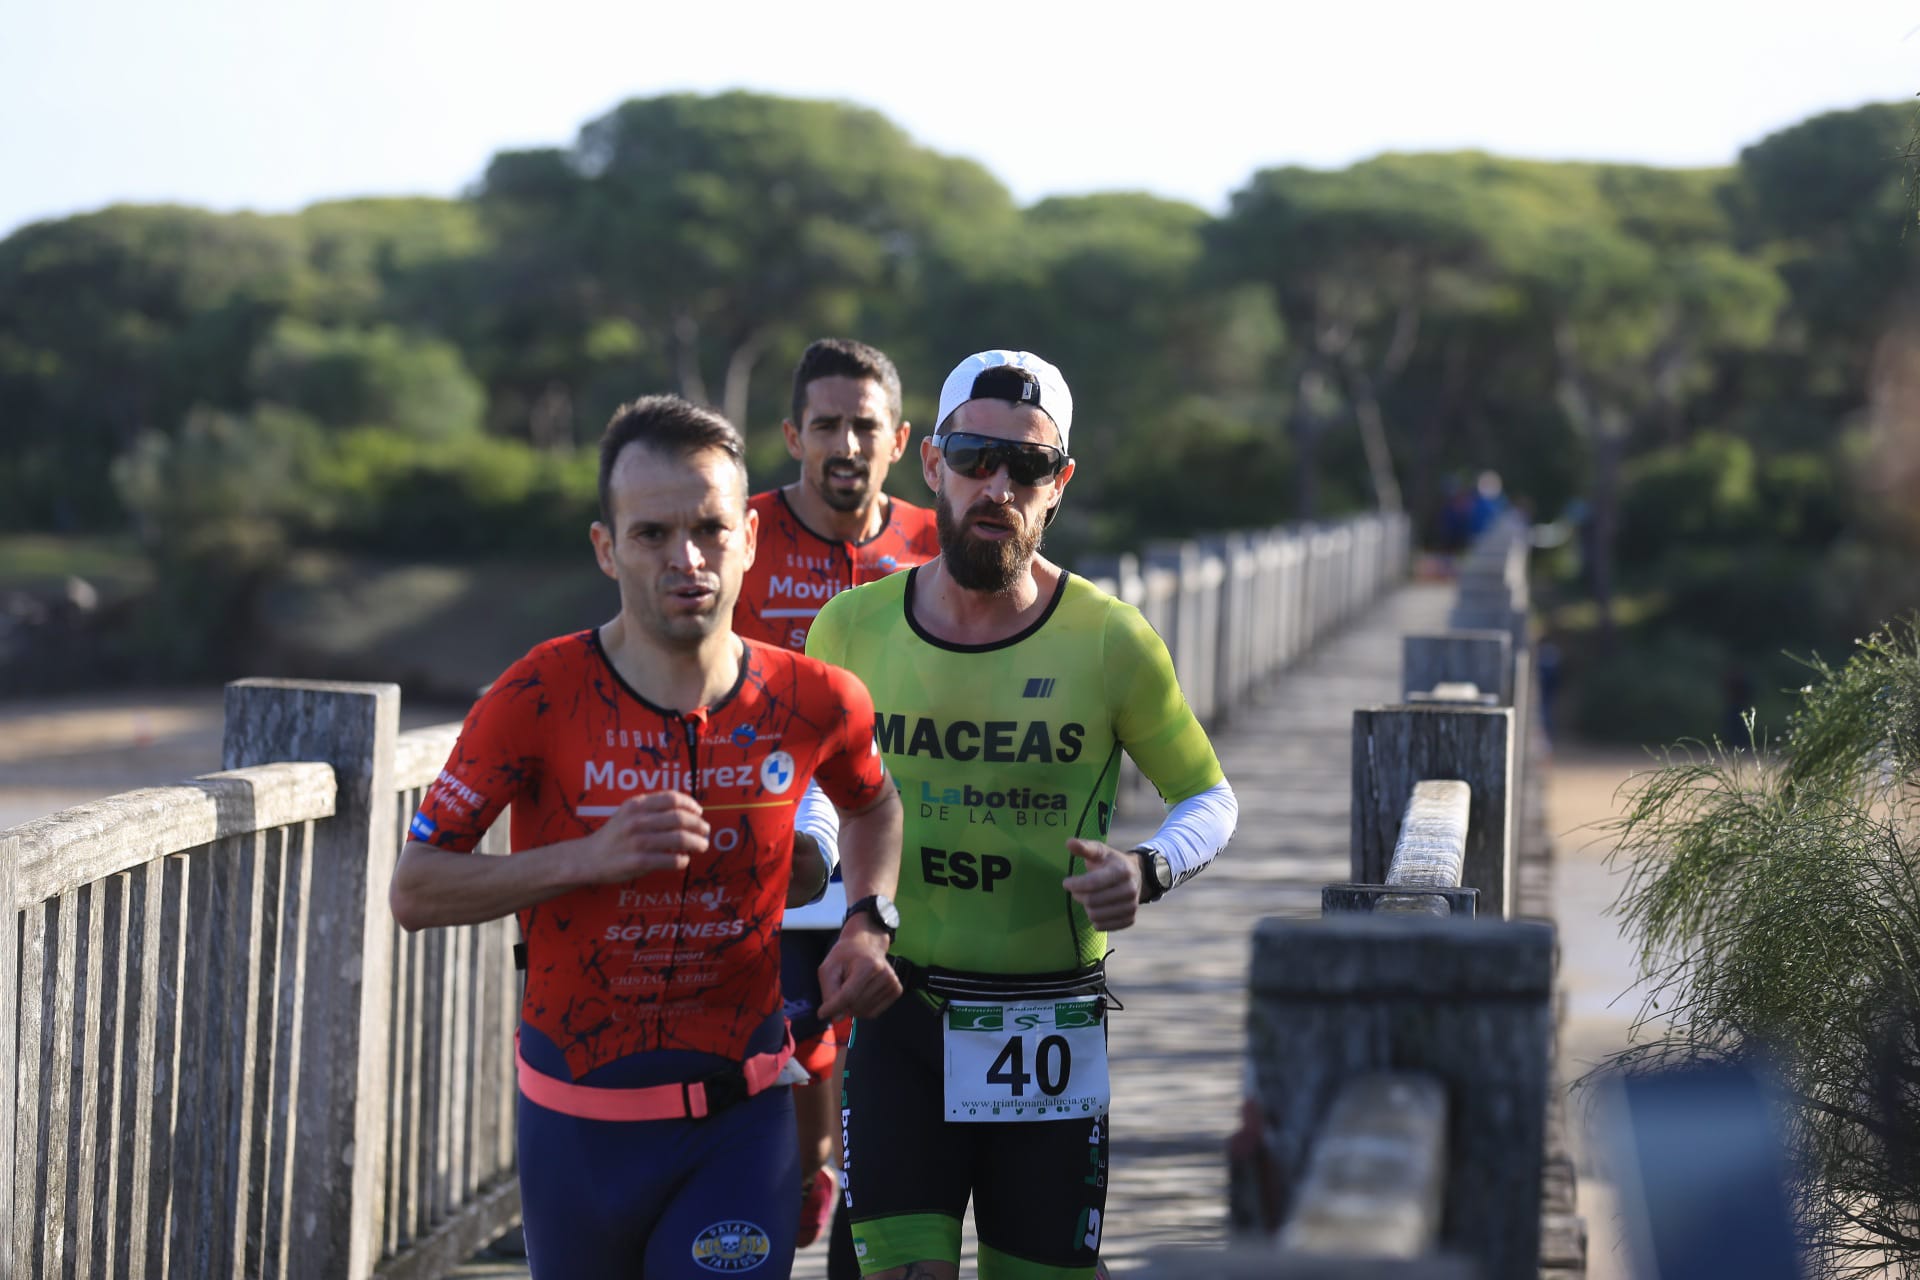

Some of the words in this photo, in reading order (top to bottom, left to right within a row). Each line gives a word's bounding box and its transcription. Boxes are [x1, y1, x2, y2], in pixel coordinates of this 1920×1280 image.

[874, 711, 1085, 763] MACEAS
[584, 760, 754, 792] Movijerez
[921, 781, 1068, 811] Labotica
[920, 803, 950, 821] DE
[969, 808, 997, 825] LA
[1016, 810, 1067, 827] BICI
[920, 846, 1012, 893] ESP
[986, 1034, 1072, 1097] 40
[961, 1096, 1096, 1109] www.triatlonandalucia.org
